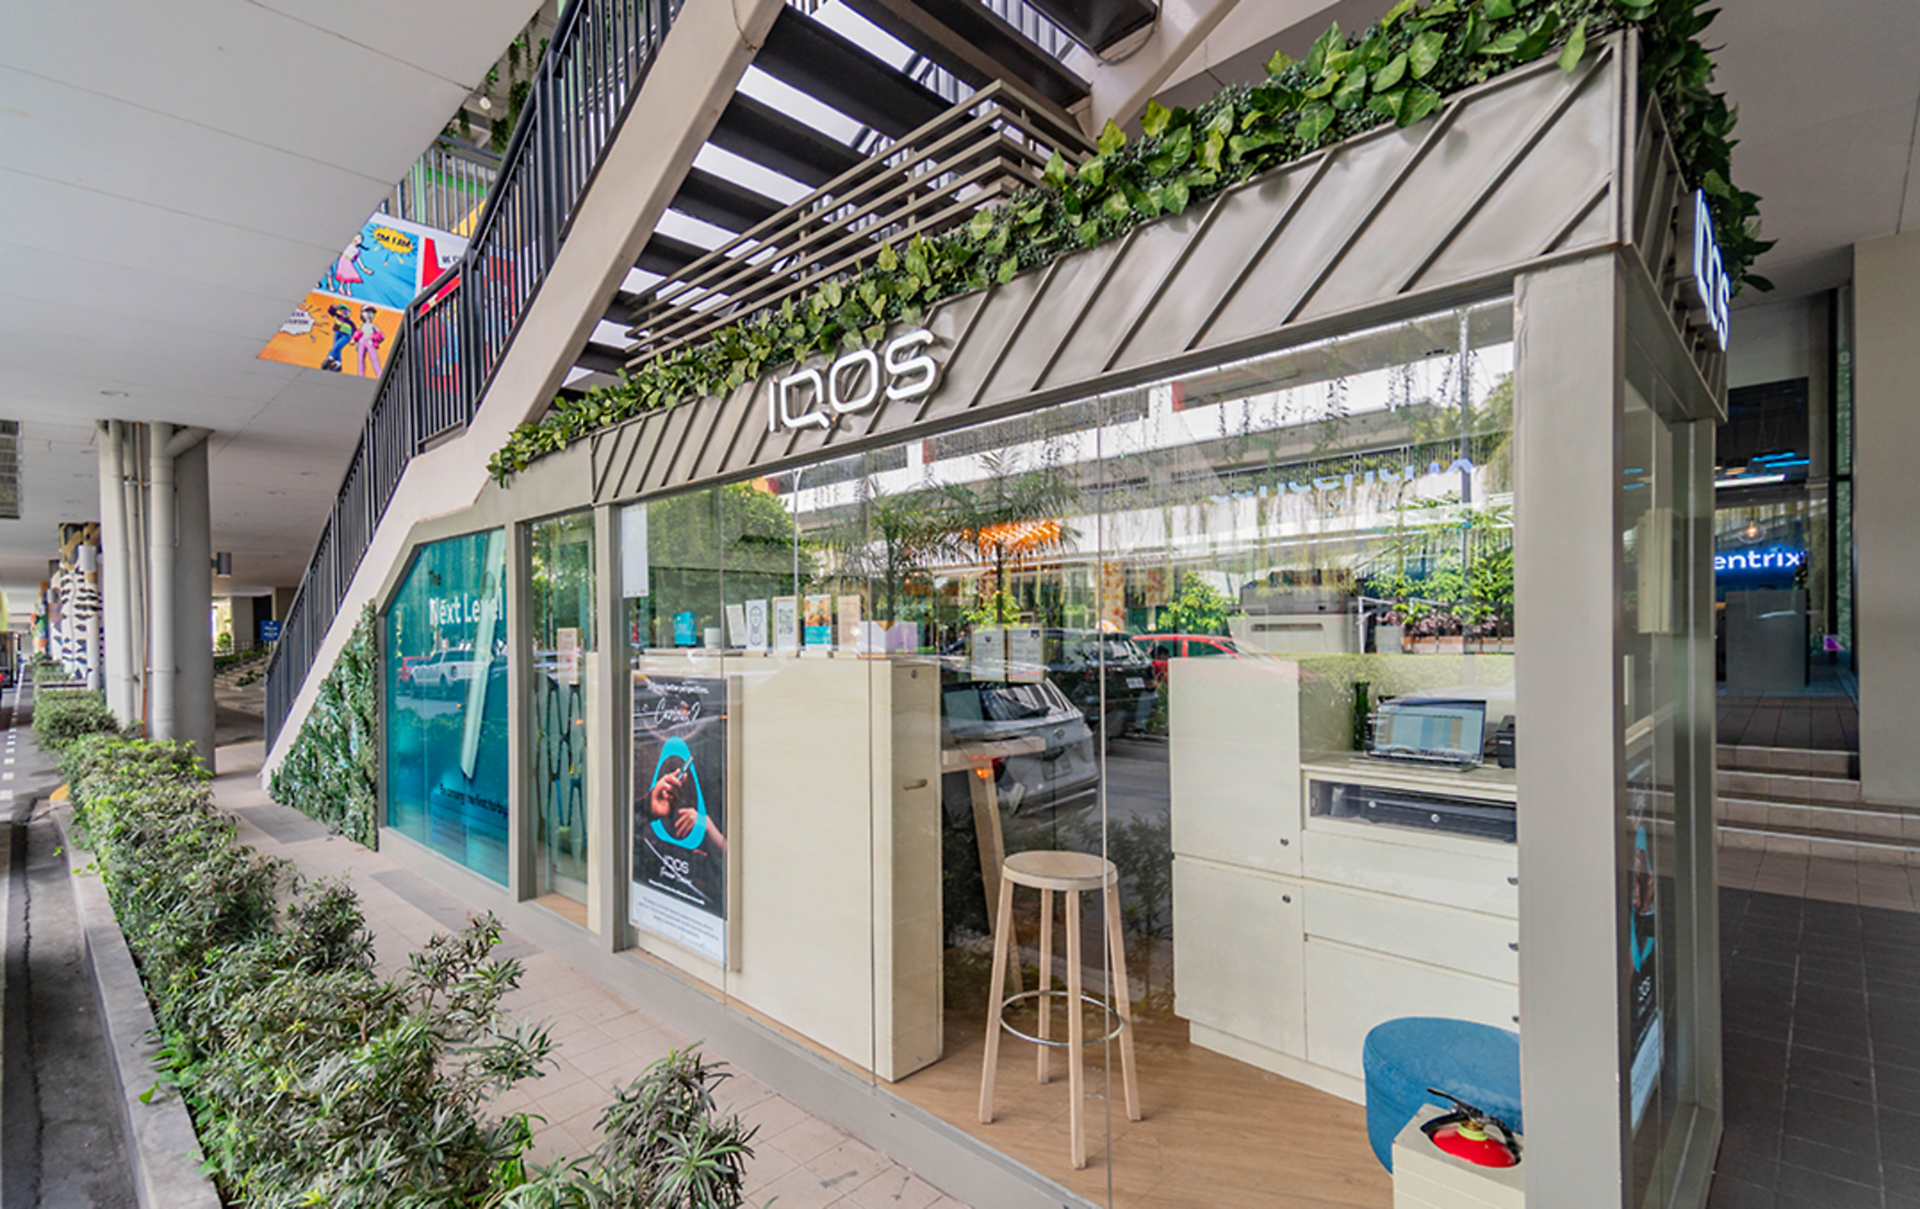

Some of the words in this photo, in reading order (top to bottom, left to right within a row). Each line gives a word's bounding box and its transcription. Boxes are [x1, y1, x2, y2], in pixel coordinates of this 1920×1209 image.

[769, 329, 936, 433] IQOS
[1713, 550, 1801, 570] entrix
[429, 595, 462, 626] Next
